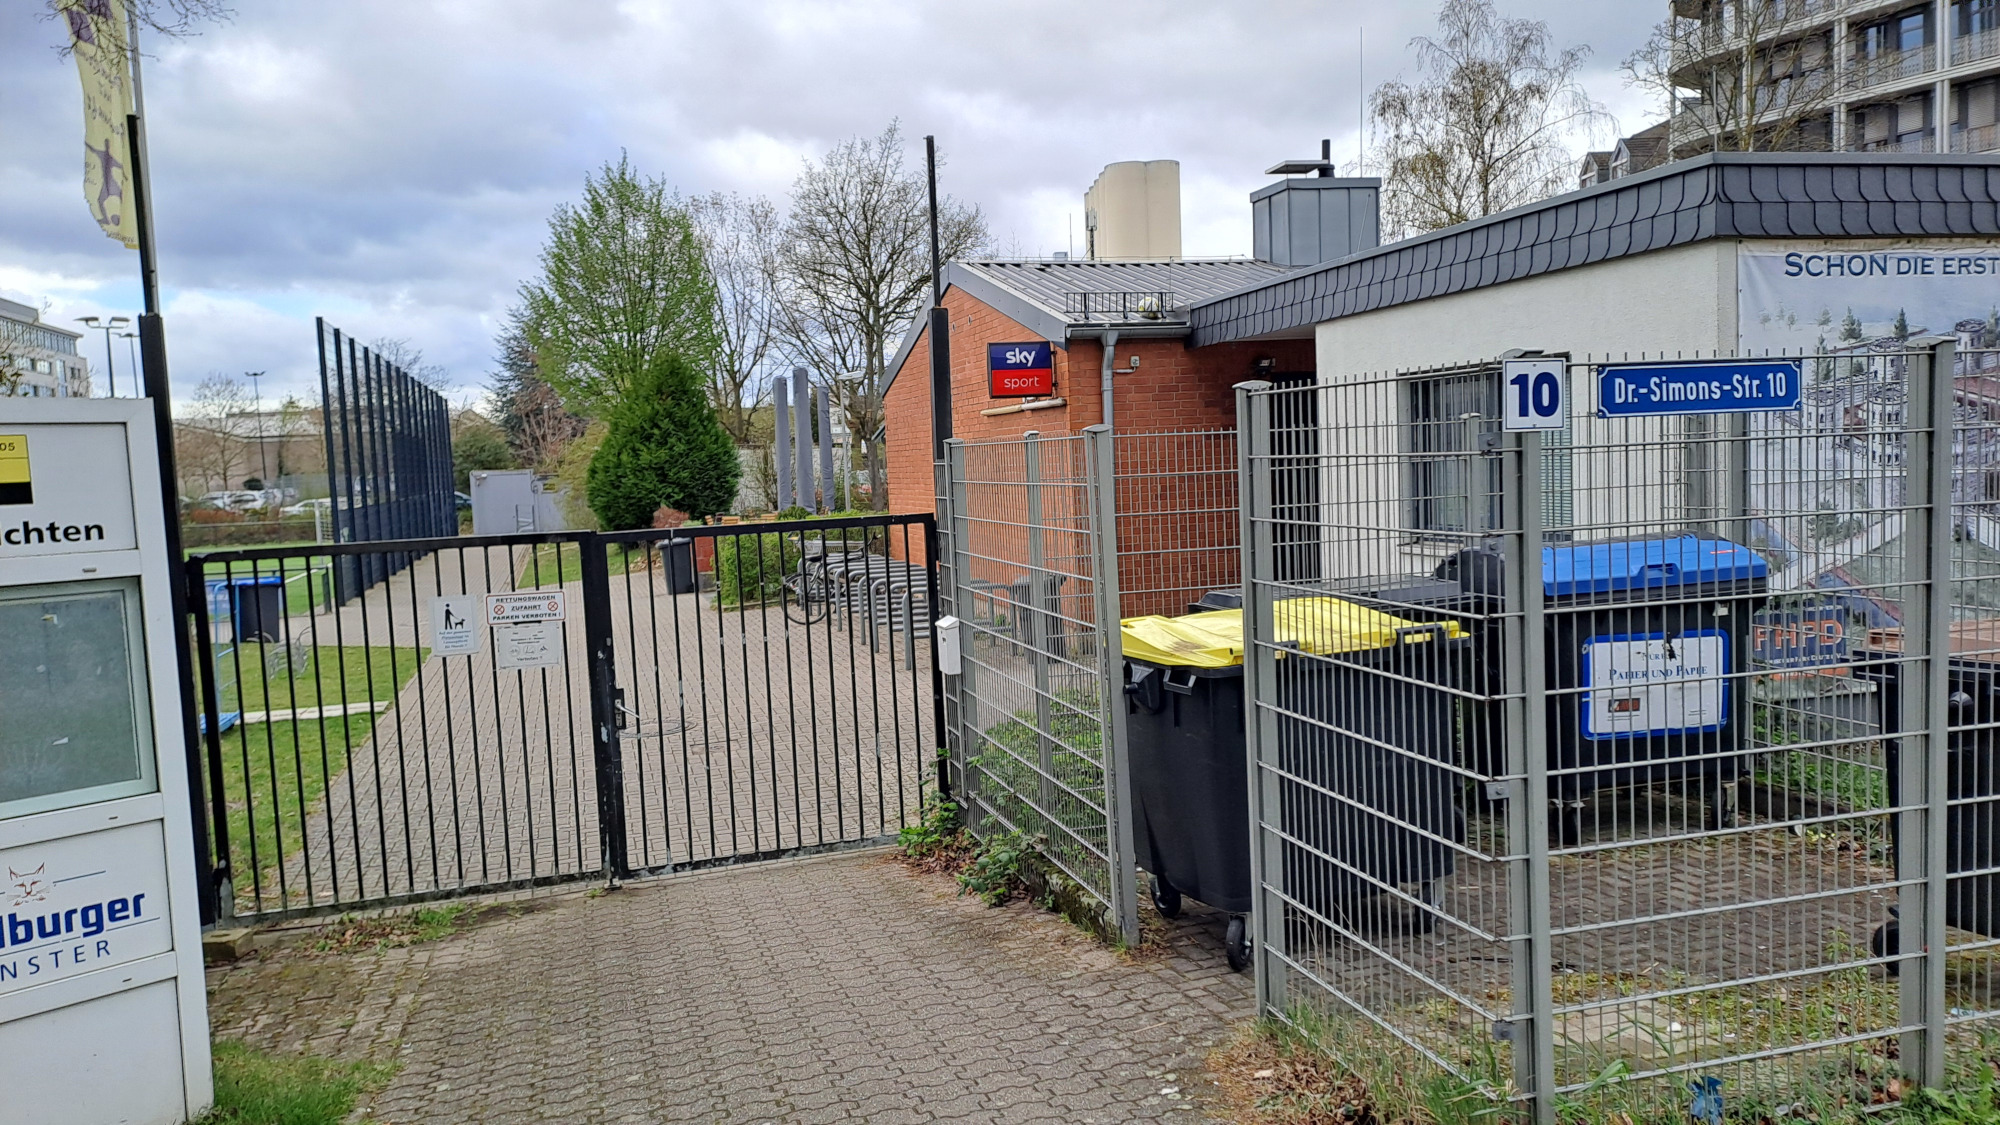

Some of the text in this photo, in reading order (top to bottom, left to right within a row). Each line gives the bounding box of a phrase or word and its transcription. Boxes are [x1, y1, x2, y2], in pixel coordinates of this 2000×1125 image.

[1784, 252, 2000, 277] SCHON DIE ERST
[1005, 347, 1036, 367] sky
[1004, 376, 1040, 390] sport
[1509, 371, 1561, 418] 10
[1613, 372, 1787, 404] Dr.-Simons-Str. 10
[0, 520, 105, 546] chten
[496, 594, 556, 604] RETTUNGSWAGEN
[1754, 619, 1843, 652] FHPD
[1649, 669, 1673, 678] UND
